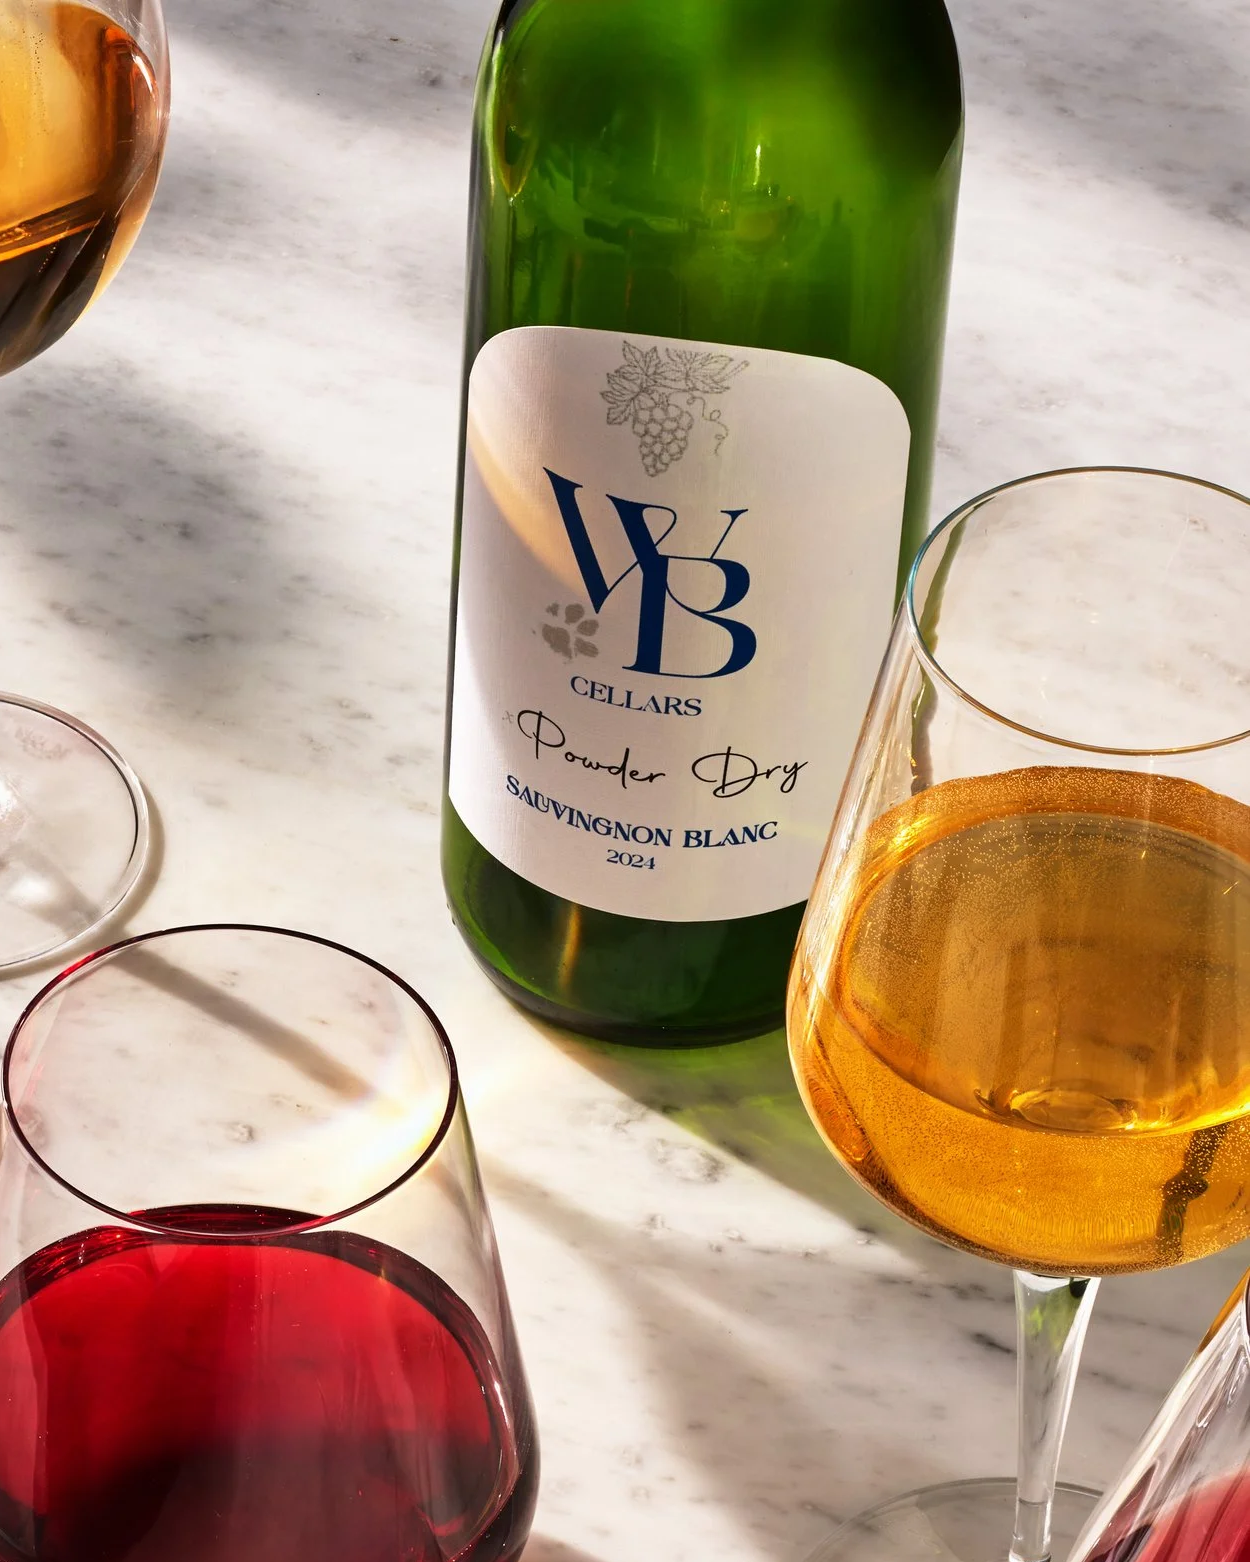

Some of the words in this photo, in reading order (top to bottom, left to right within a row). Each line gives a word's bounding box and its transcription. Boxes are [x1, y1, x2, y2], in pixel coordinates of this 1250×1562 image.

[569, 675, 703, 717] CELLARS
[517, 709, 666, 790] Powder
[691, 745, 809, 799] Dry
[505, 774, 673, 847] SAUVINGNON
[682, 820, 779, 849] BLANC
[606, 849, 656, 870] 2024
